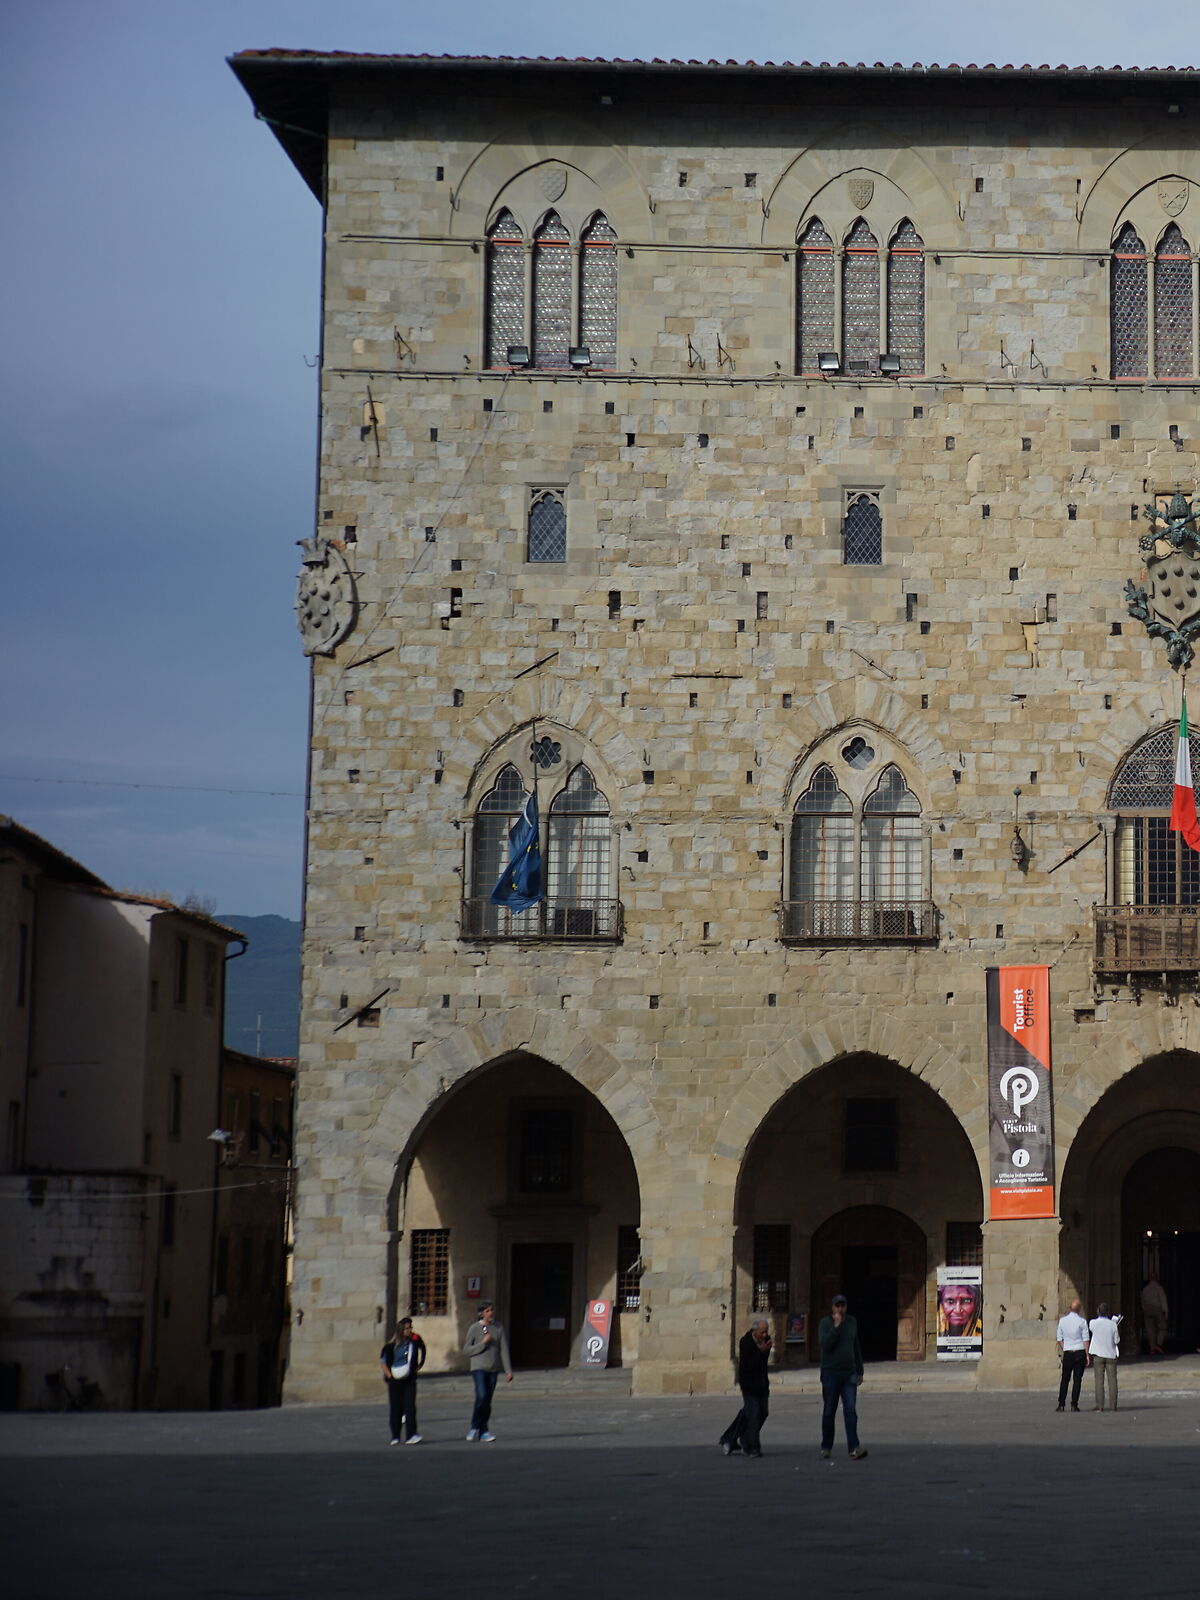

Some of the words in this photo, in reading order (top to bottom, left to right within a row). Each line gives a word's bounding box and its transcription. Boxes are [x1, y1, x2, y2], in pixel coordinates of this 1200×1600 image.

[1013, 988, 1024, 1032] Tourist
[1024, 989, 1034, 1027] Office
[1003, 1122, 1037, 1133] Pistoia
